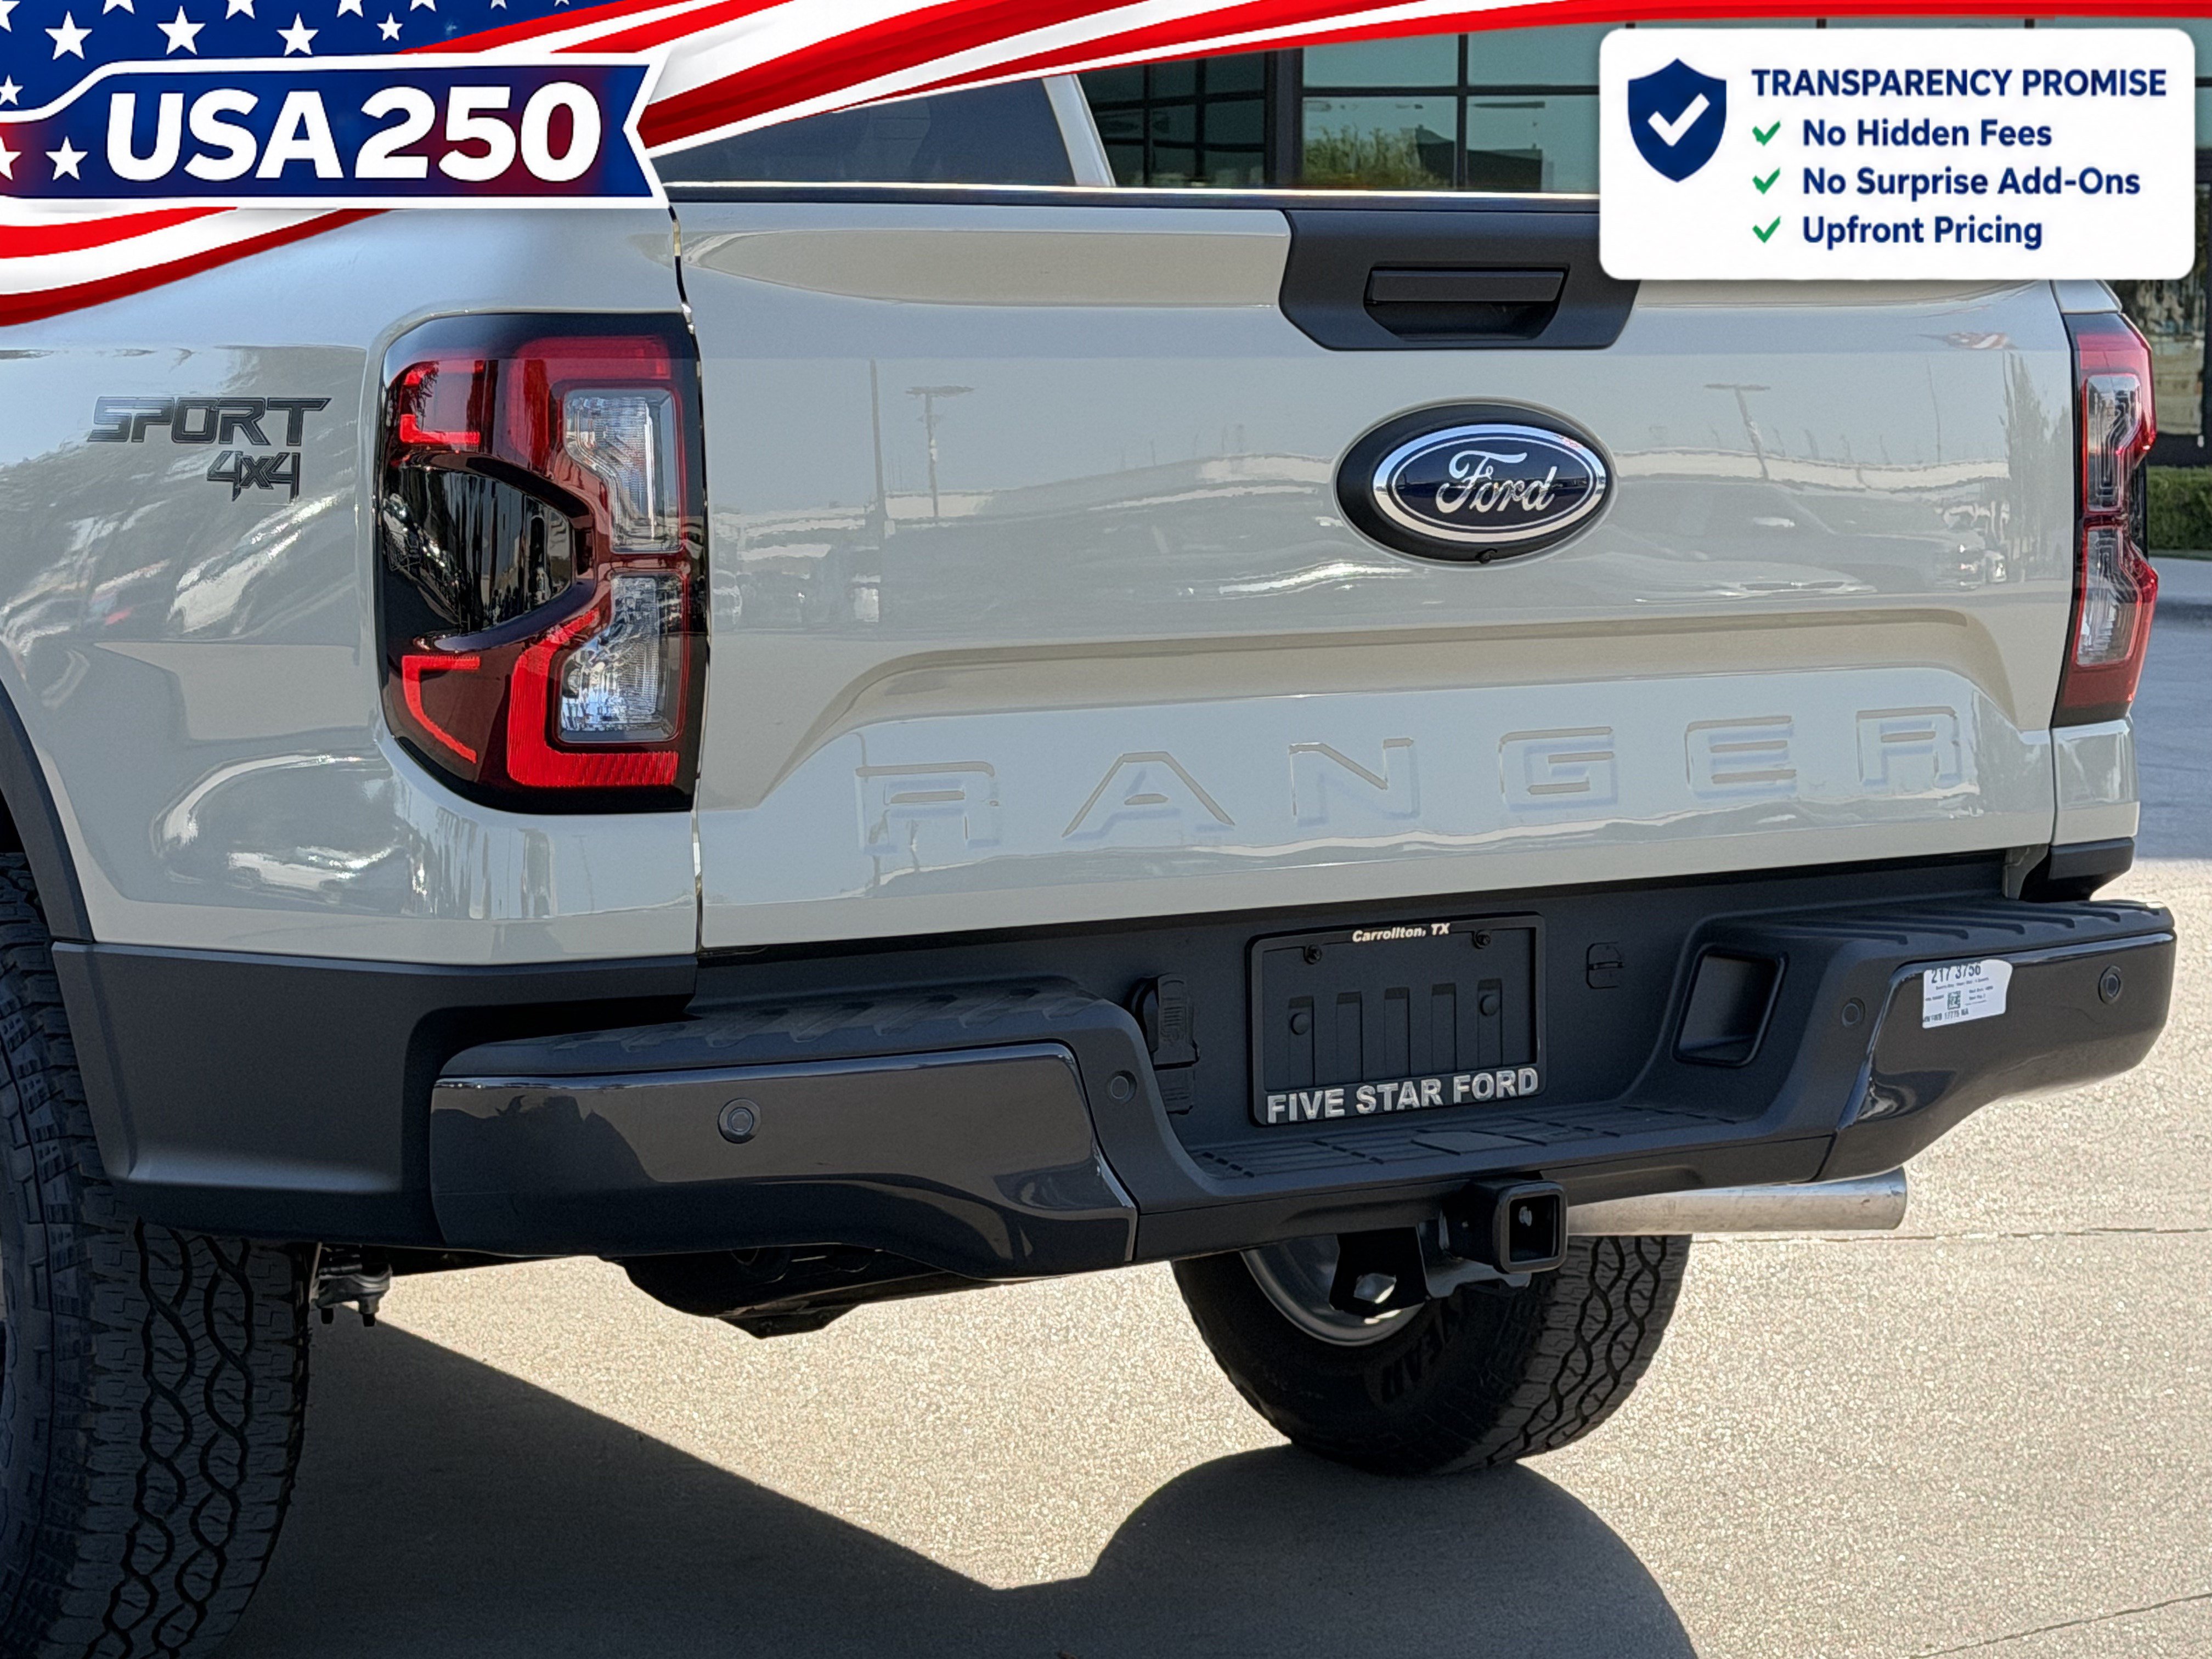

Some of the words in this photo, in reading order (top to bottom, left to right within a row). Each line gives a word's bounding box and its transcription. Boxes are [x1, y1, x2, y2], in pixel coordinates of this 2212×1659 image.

[87, 396, 332, 447] SPORT
[206, 450, 301, 503] 4x4
[1435, 449, 1558, 514] Ford
[855, 706, 1963, 854] RANGER
[1352, 927, 1426, 943] Carrollton,
[1431, 922, 1451, 936] TX
[1267, 1088, 1345, 1124] FIVE
[1356, 1078, 1444, 1114] STAR
[1453, 1068, 1538, 1104] FORD
